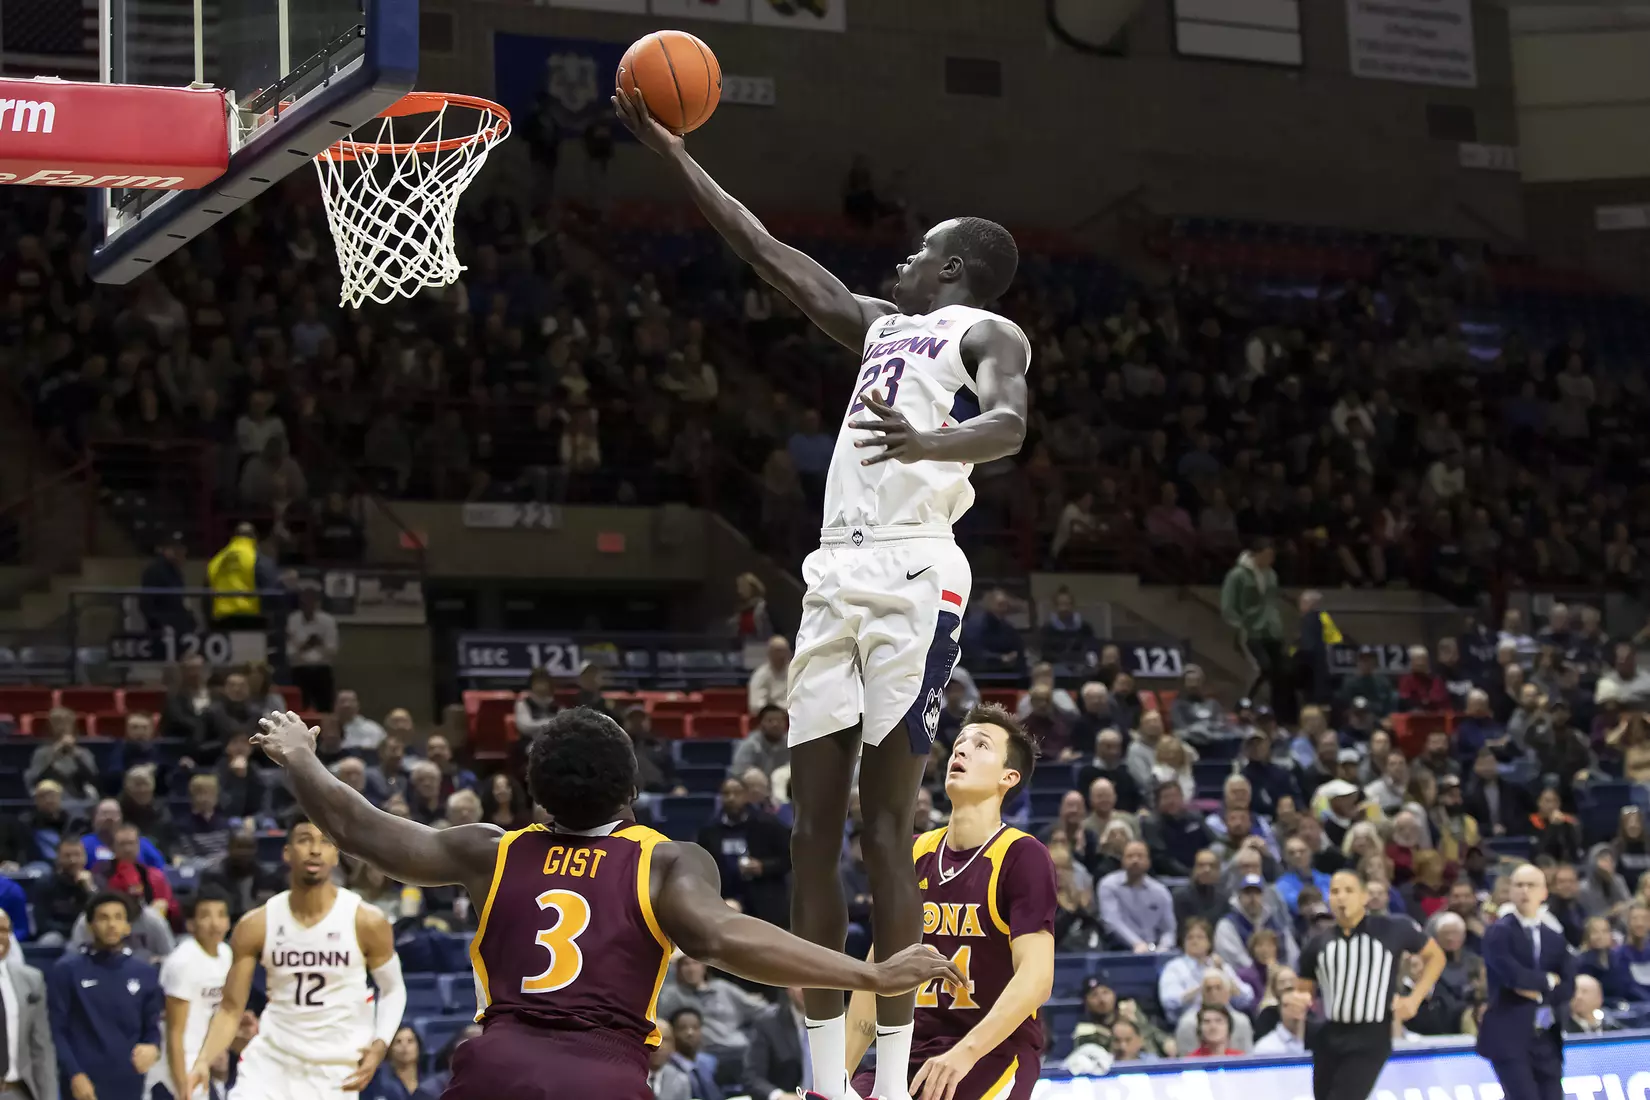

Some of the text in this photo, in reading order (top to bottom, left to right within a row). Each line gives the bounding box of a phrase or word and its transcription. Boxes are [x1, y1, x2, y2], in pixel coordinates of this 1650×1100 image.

[13, 169, 185, 189] Farm
[861, 336, 949, 366] UCONN
[848, 357, 906, 417] 23
[111, 632, 229, 665] SEC 120
[468, 644, 581, 673] SEC 121
[1133, 647, 1182, 676] 121
[543, 846, 607, 878] GIST
[923, 901, 986, 937] ONA
[521, 889, 591, 994] 3
[271, 951, 349, 968] UCONN
[293, 972, 327, 1006] 12
